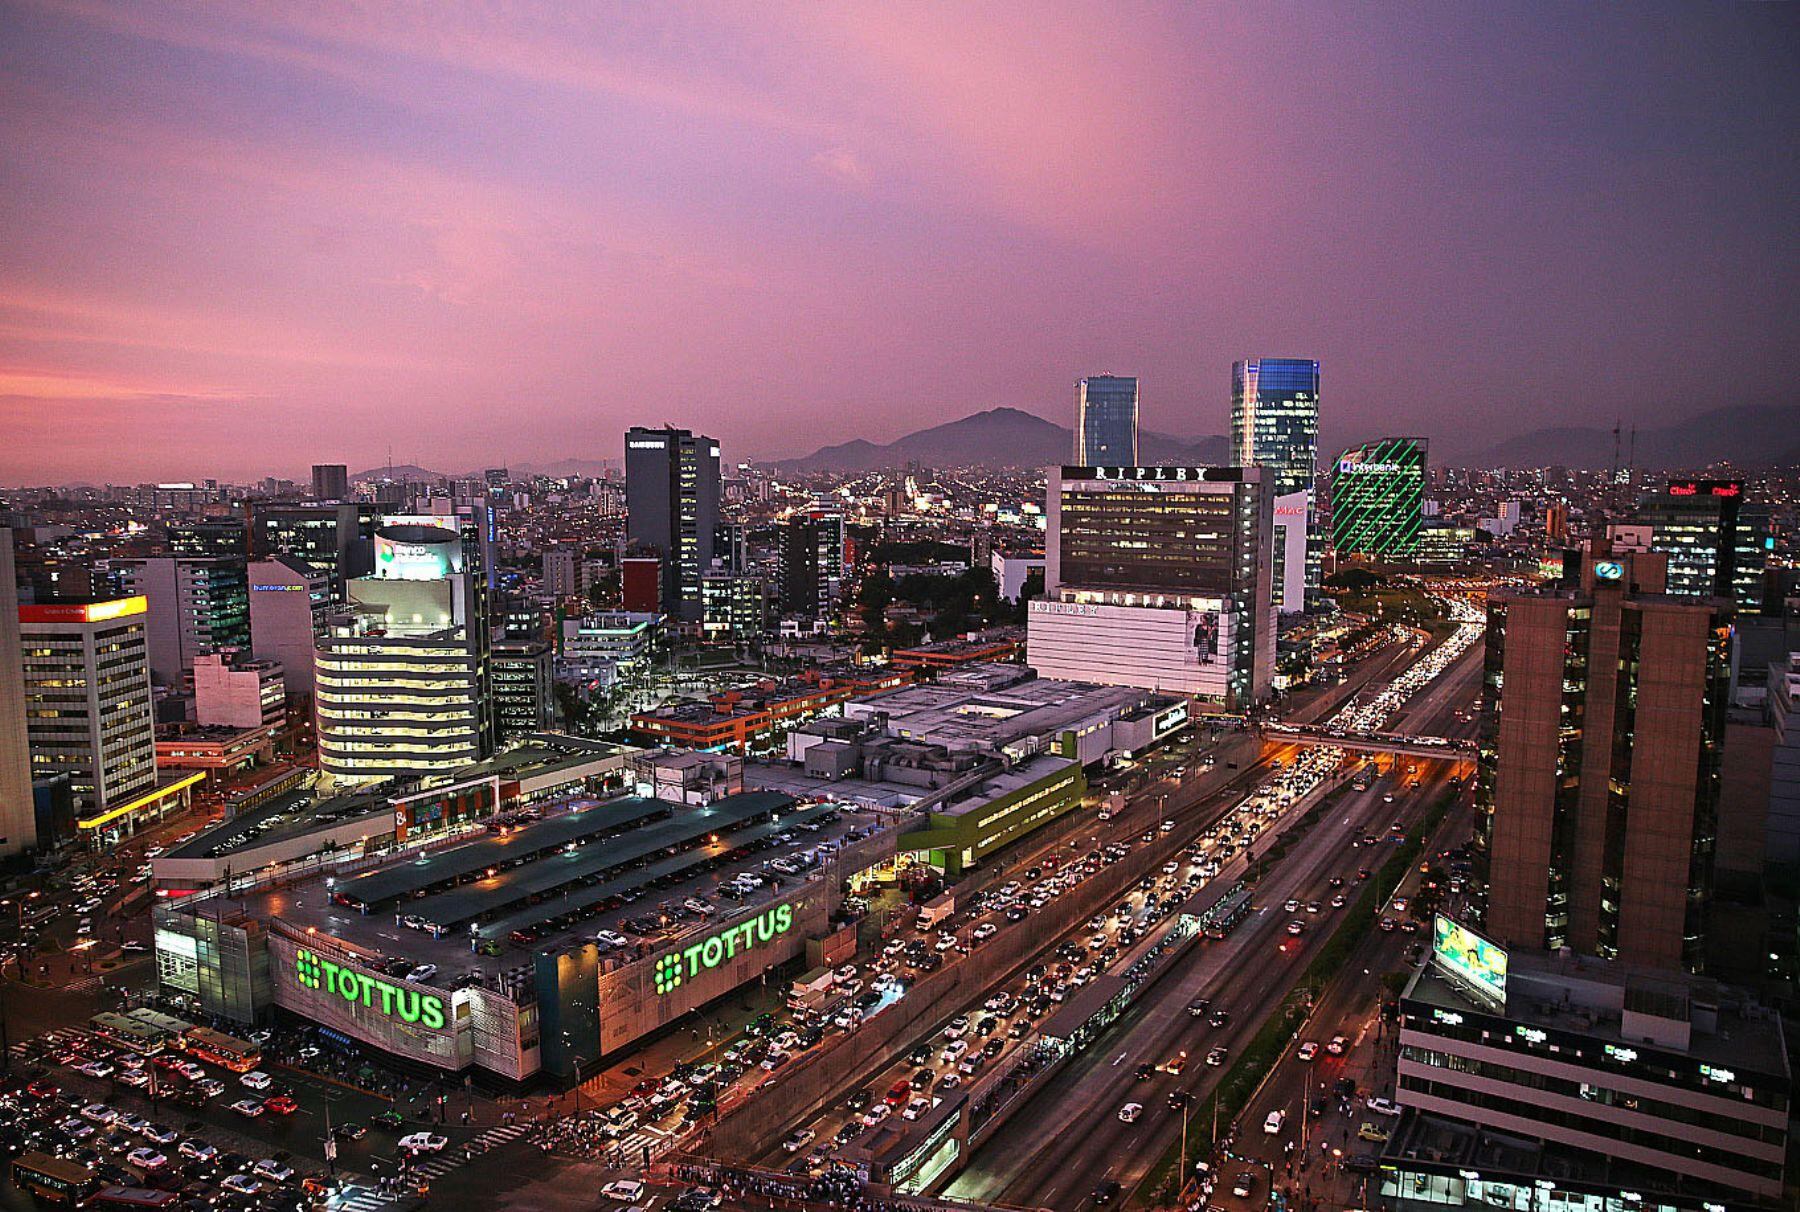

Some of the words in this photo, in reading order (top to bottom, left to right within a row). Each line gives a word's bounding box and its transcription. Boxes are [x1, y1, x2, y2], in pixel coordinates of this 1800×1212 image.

[1095, 466, 1208, 481] RIPLEY
[1033, 602, 1098, 617] RIPLEY
[684, 903, 793, 978] TOTTUS
[320, 960, 446, 1030] TOTTUS
